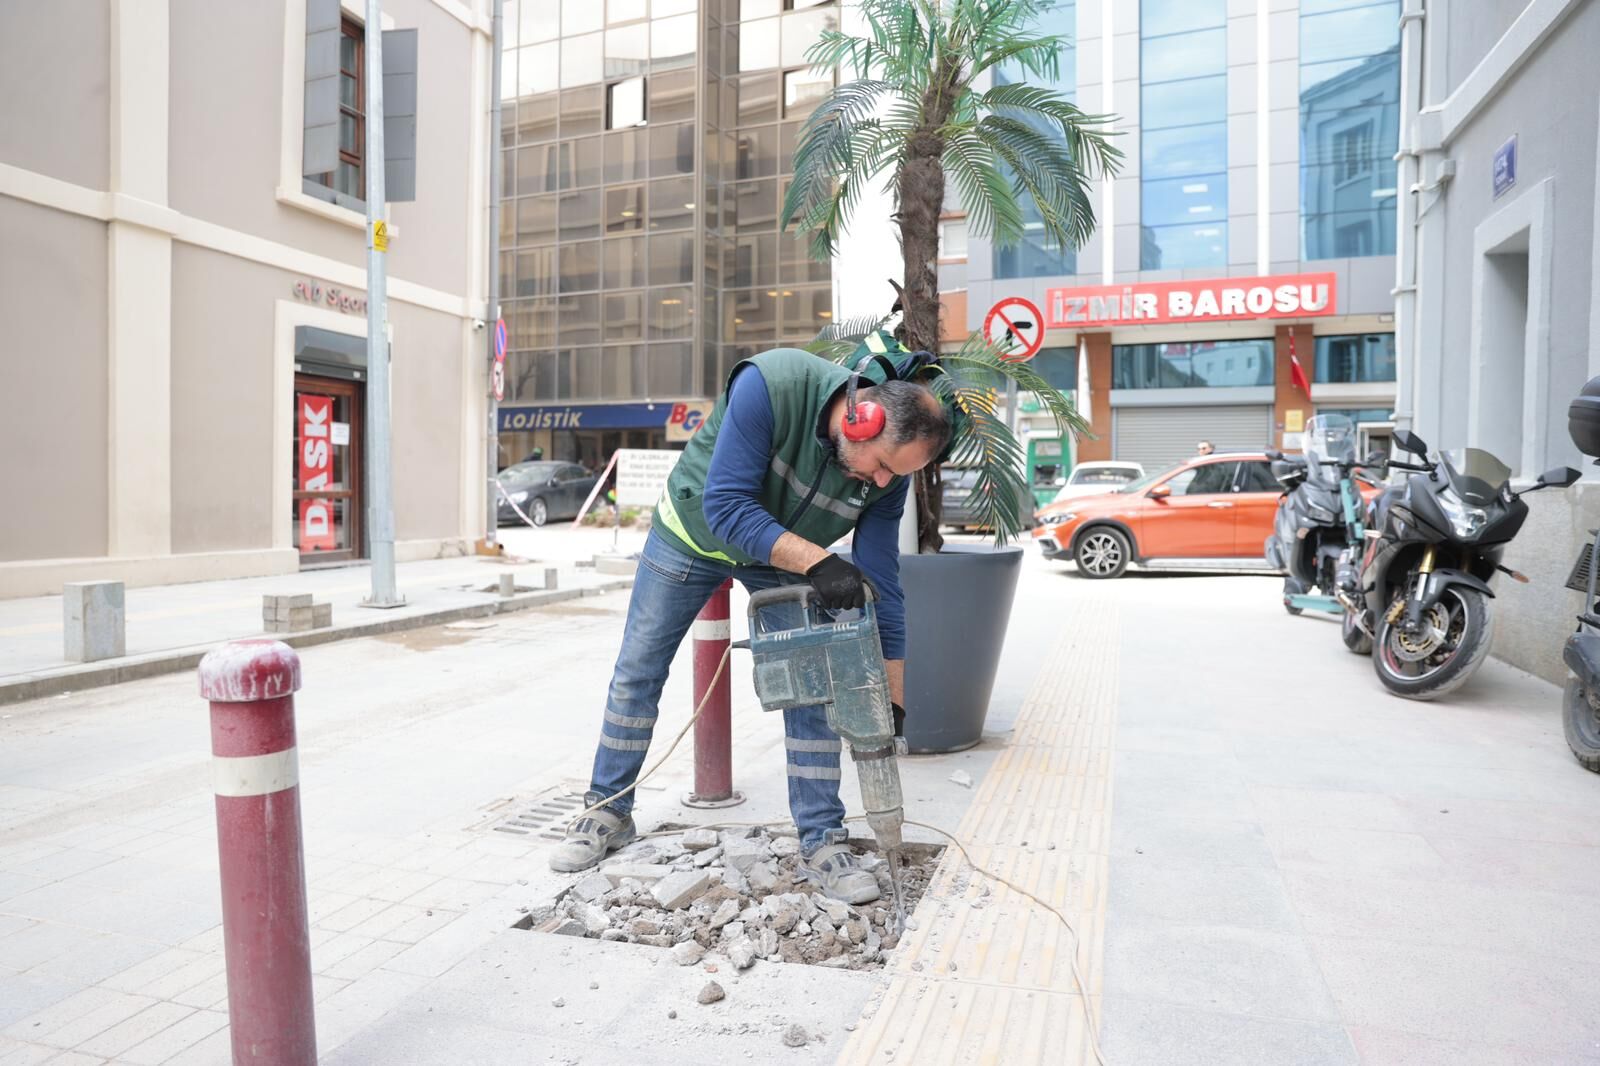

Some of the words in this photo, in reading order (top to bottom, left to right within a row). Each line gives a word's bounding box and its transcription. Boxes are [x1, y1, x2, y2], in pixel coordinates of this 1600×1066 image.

[1053, 287, 1159, 323] İZMİR
[1168, 284, 1329, 318] BAROSU
[504, 408, 583, 430] LOJİSTİK
[671, 401, 706, 432] BG
[304, 403, 328, 537] DASK
